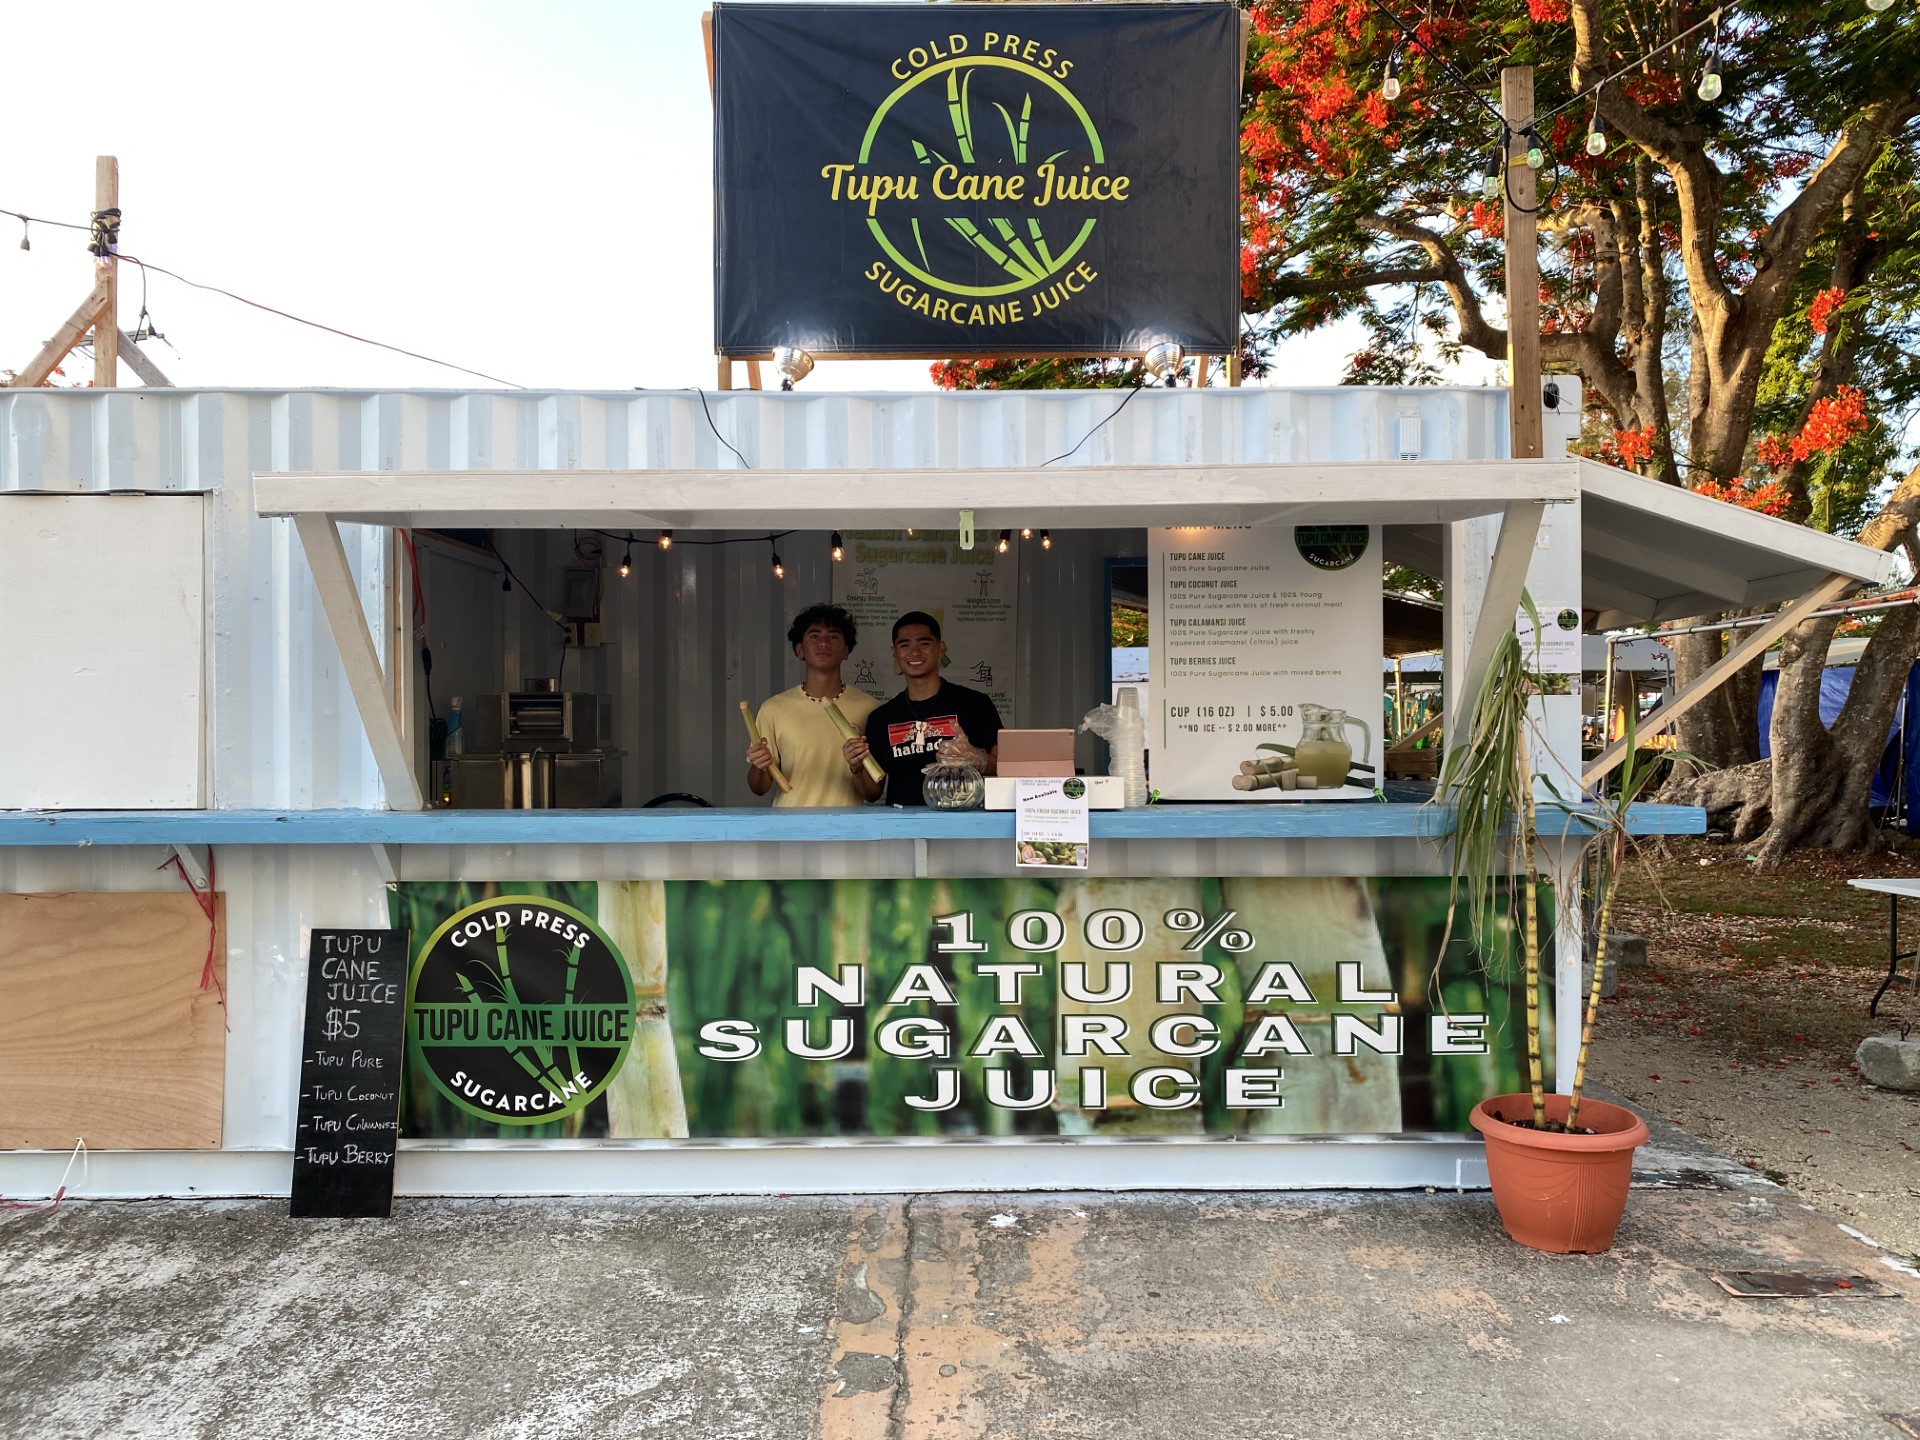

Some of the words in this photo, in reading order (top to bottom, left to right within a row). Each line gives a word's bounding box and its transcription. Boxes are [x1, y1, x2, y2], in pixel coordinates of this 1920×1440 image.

[891, 33, 969, 81] COLD
[984, 31, 1075, 81] PRESS
[820, 162, 919, 217] Tupu
[931, 163, 1025, 202] Cane
[1032, 162, 1131, 207] Juice
[864, 260, 1025, 327] SUGARCANE
[1031, 260, 1099, 318] JUICE
[1321, 533, 1343, 544] CANE
[855, 542, 947, 567] Sugarcane
[1170, 552, 1187, 561] TUPU
[1188, 552, 1206, 561] CANE
[1207, 552, 1225, 560] JUICE
[1308, 552, 1355, 567] SUGARCANE
[1208, 564, 1248, 573] Sugarcane
[1170, 580, 1187, 589] TUPU
[1188, 580, 1218, 588] COCONUT
[1220, 580, 1238, 588] JUICE
[1208, 592, 1248, 601] Sugarcane
[1299, 591, 1323, 599] Young
[1170, 618, 1187, 627] TUPU
[1188, 618, 1226, 627] CALAMANSI
[1228, 618, 1246, 626] JUICE
[1208, 629, 1248, 637] Sugarcane
[1290, 628, 1315, 636] freshly
[1170, 640, 1205, 648] squeezed
[1249, 638, 1278, 646] (citrus)
[1280, 638, 1299, 646] juice
[1170, 657, 1187, 666] TUPU
[1188, 657, 1217, 665] BERRIES
[1218, 657, 1236, 665] JUICE
[1208, 670, 1248, 678] Sugarcane
[1170, 707, 1190, 717] CUP
[1197, 706, 1214, 717] (16
[1218, 706, 1235, 717] OZ)
[1270, 705, 1294, 716] 5.00
[1203, 724, 1216, 733] ICE
[1235, 724, 1253, 732] 2.00
[450, 910, 511, 948] COLD
[520, 909, 590, 949] PRESS
[932, 907, 1257, 954] 100%
[320, 935, 382, 957] TUPU
[321, 958, 382, 981] CANE
[326, 982, 398, 1004] JUICE
[796, 961, 1399, 1006] NATURAL
[321, 1006, 361, 1041] $5
[413, 1008, 479, 1041] TUPU
[487, 1008, 554, 1041] CANE
[561, 1009, 629, 1042] JUICE
[696, 1012, 1492, 1061] SUGARCANE
[450, 1070, 593, 1112] SUGARCANE
[904, 1065, 1285, 1111] JUICE
[341, 1143, 393, 1166] BERRY
